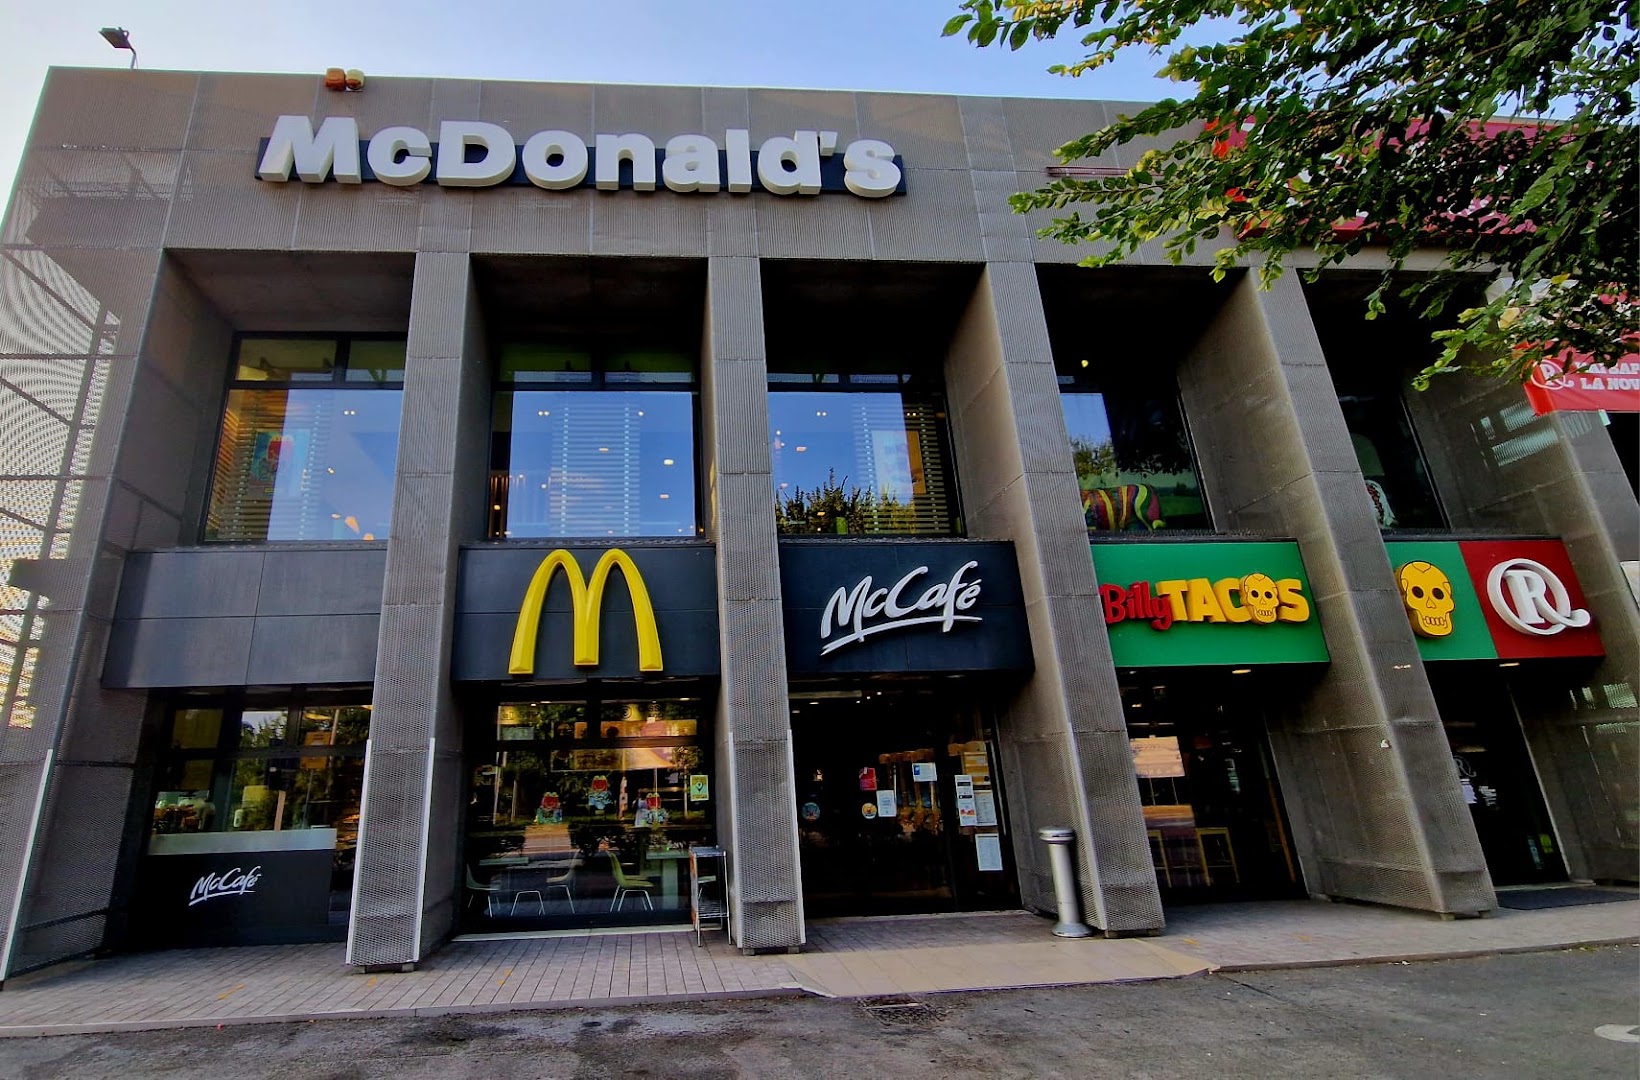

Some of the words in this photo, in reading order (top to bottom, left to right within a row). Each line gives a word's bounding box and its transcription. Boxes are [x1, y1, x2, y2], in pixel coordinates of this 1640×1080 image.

[257, 115, 902, 198] McDonald's
[1580, 378, 1605, 390] LA
[820, 560, 982, 645] McCafé
[1100, 581, 1173, 631] Billy
[189, 865, 262, 903] McCafé
